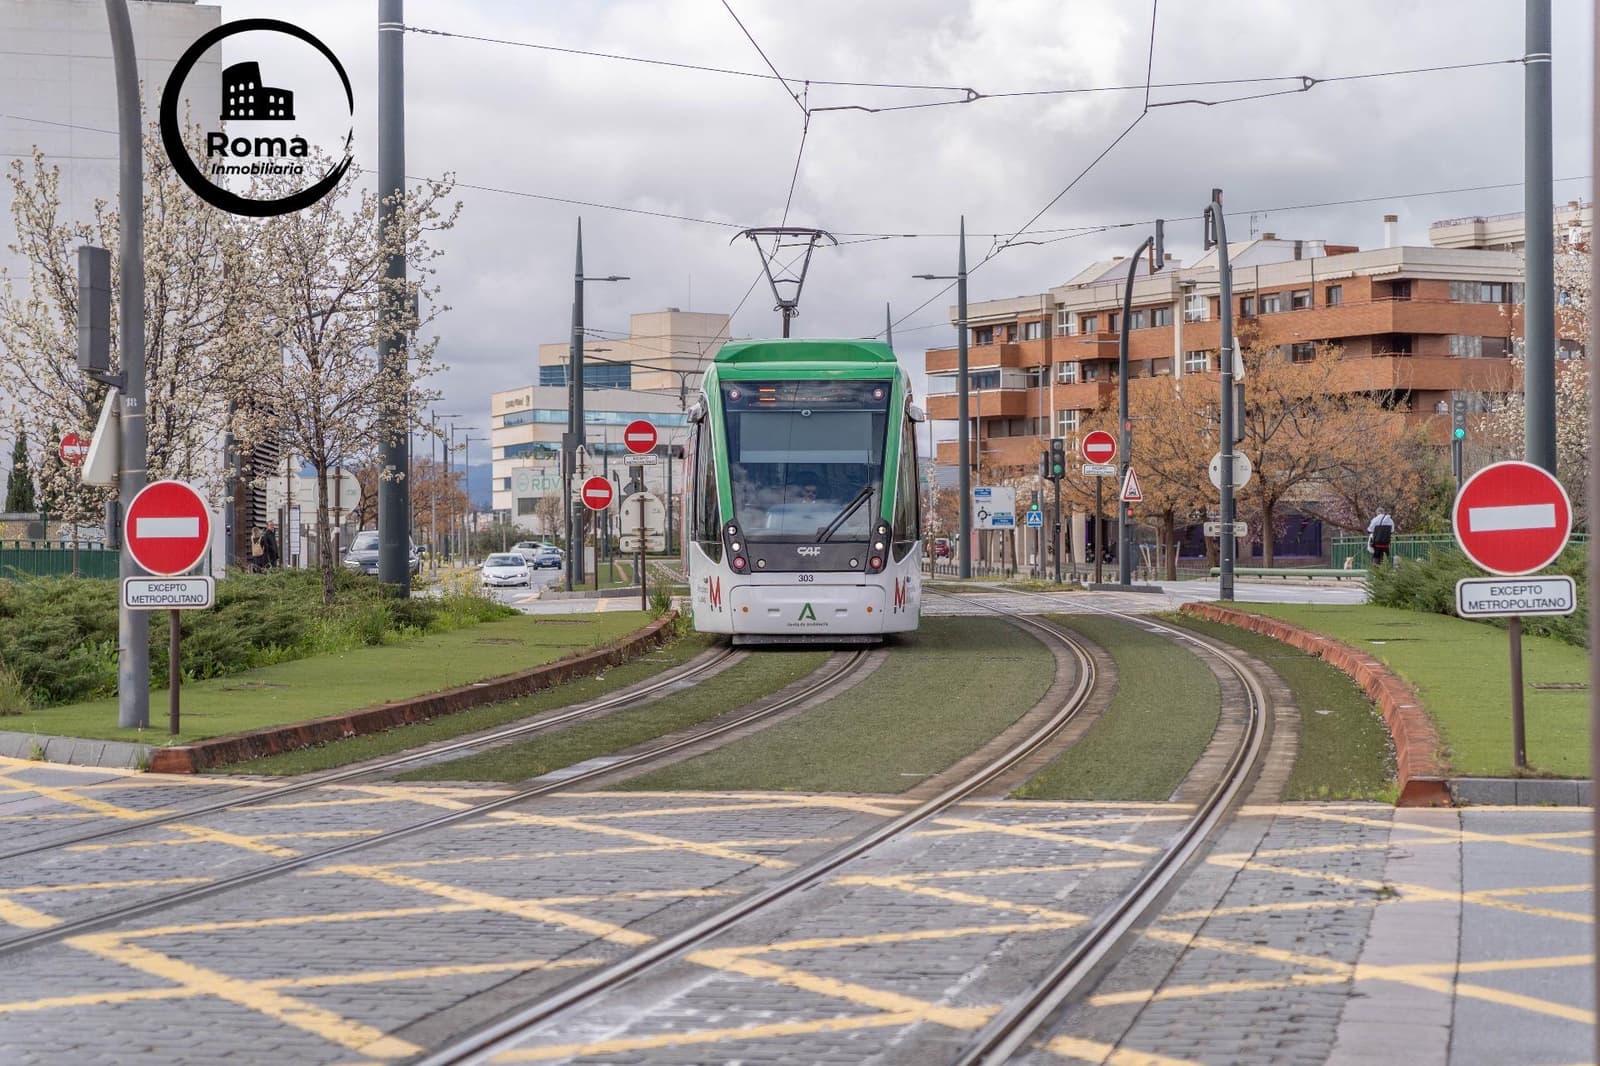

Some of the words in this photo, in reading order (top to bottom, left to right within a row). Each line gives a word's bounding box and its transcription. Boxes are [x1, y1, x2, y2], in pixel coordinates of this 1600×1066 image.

[797, 546, 821, 557] CAF
[798, 574, 814, 582] 303
[148, 583, 187, 592] EXCEPTO
[1490, 584, 1543, 597] EXCEPTO
[131, 594, 204, 603] METROPOLITANO
[1468, 598, 1566, 611] METROPOLITANO
